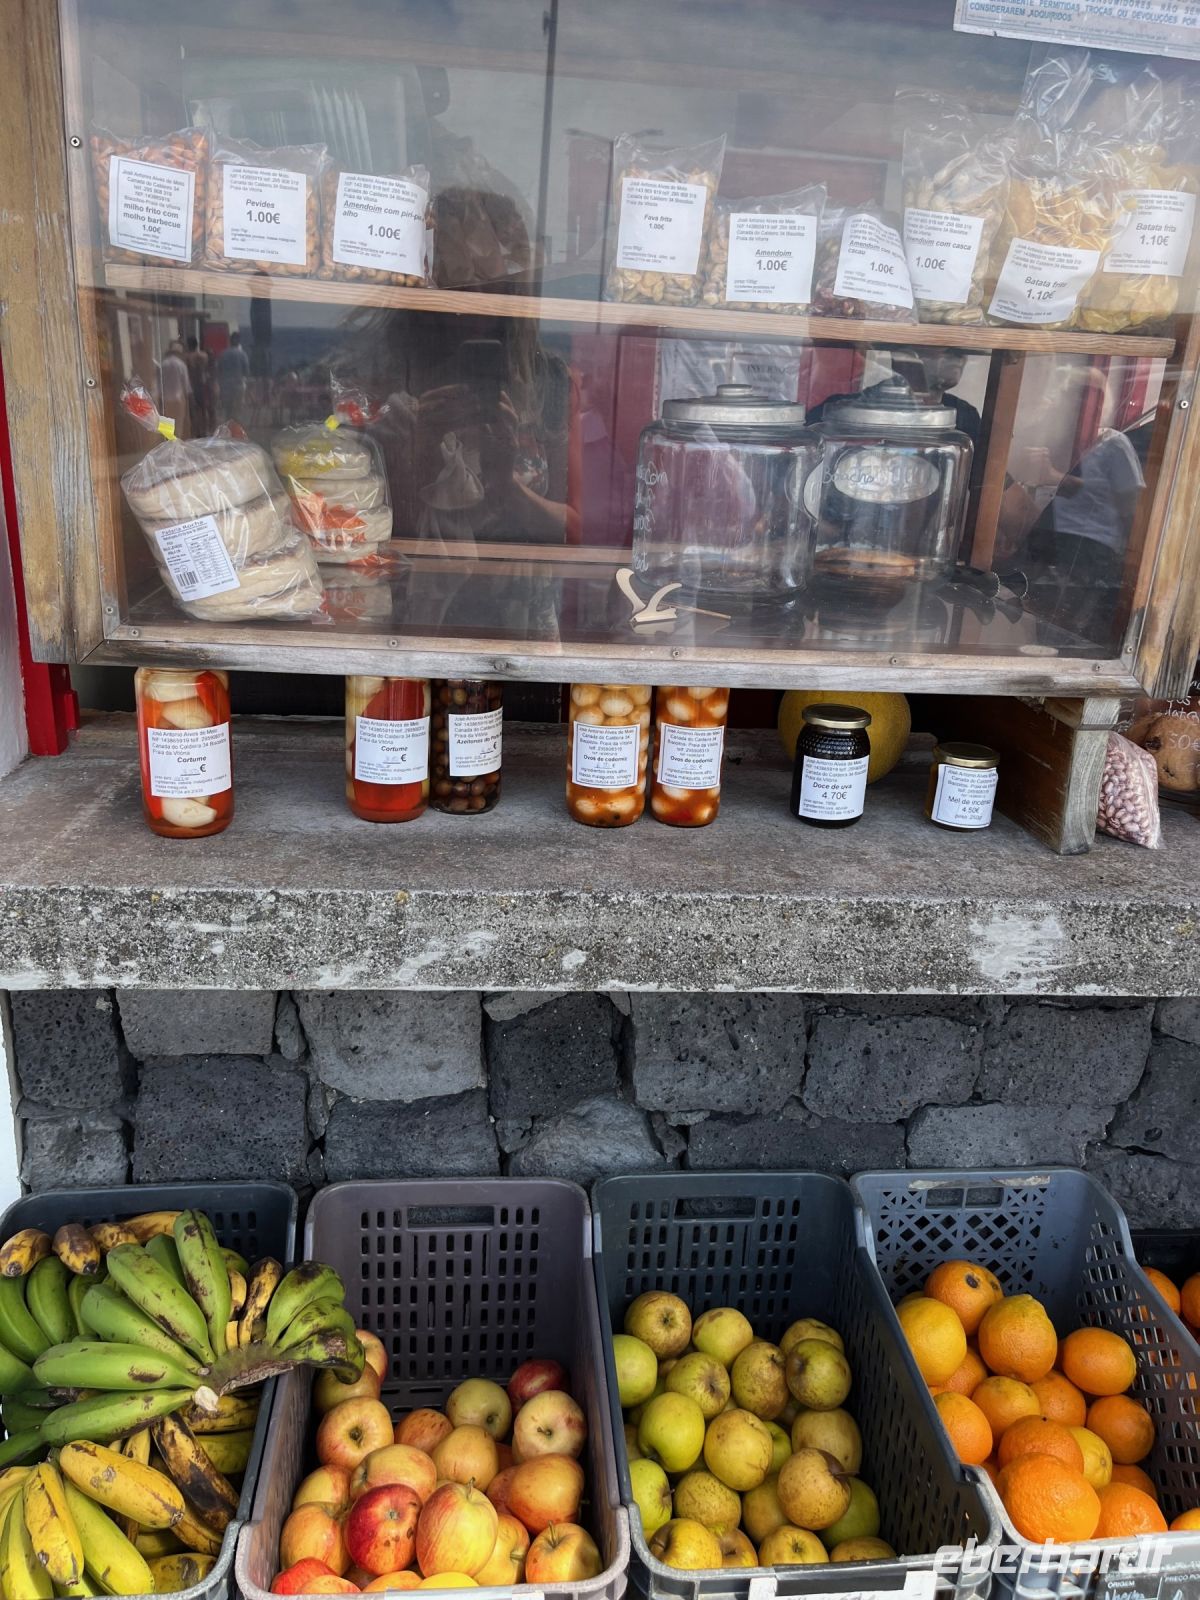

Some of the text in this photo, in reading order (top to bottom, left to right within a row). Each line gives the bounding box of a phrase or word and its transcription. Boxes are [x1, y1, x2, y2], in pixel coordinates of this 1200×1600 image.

[969, 3, 1026, 16] CONSIDERAREM
[1040, 0, 1080, 12] PERMITIDAS
[1086, 5, 1112, 16] TROCAS
[1118, 9, 1128, 18] OU
[1160, 3, 1178, 13] NÃO
[246, 198, 275, 209] Pevides
[344, 200, 383, 213] Amendoim
[384, 207, 400, 216] com
[124, 203, 179, 219] milho frito com
[342, 209, 358, 218] alho
[123, 212, 181, 228] molho barbecue
[246, 210, 281, 224] 1.00€
[644, 214, 659, 222] Fava
[142, 224, 161, 234] 1.00€
[368, 224, 401, 240] 1.00€
[1136, 222, 1177, 233] Batata frita
[849, 240, 880, 249] Amendoim
[935, 240, 951, 248] com
[952, 243, 972, 251] casca
[1140, 234, 1170, 246] 1.10€
[755, 249, 792, 257] Amendoim
[757, 259, 788, 271] 1.00€
[870, 261, 895, 275] 1.00€
[915, 256, 946, 271] 1.00€
[1025, 276, 1051, 288] Batata
[1026, 289, 1056, 301] 1.10€
[583, 754, 597, 762] Ovos
[670, 755, 683, 763] Ovos
[812, 781, 830, 790] Doce
[821, 791, 848, 801] 4.70€
[947, 795, 960, 804] Mel
[1107, 1580, 1136, 1589] ORIGEM
[1165, 1575, 1189, 1583] PREÇO
